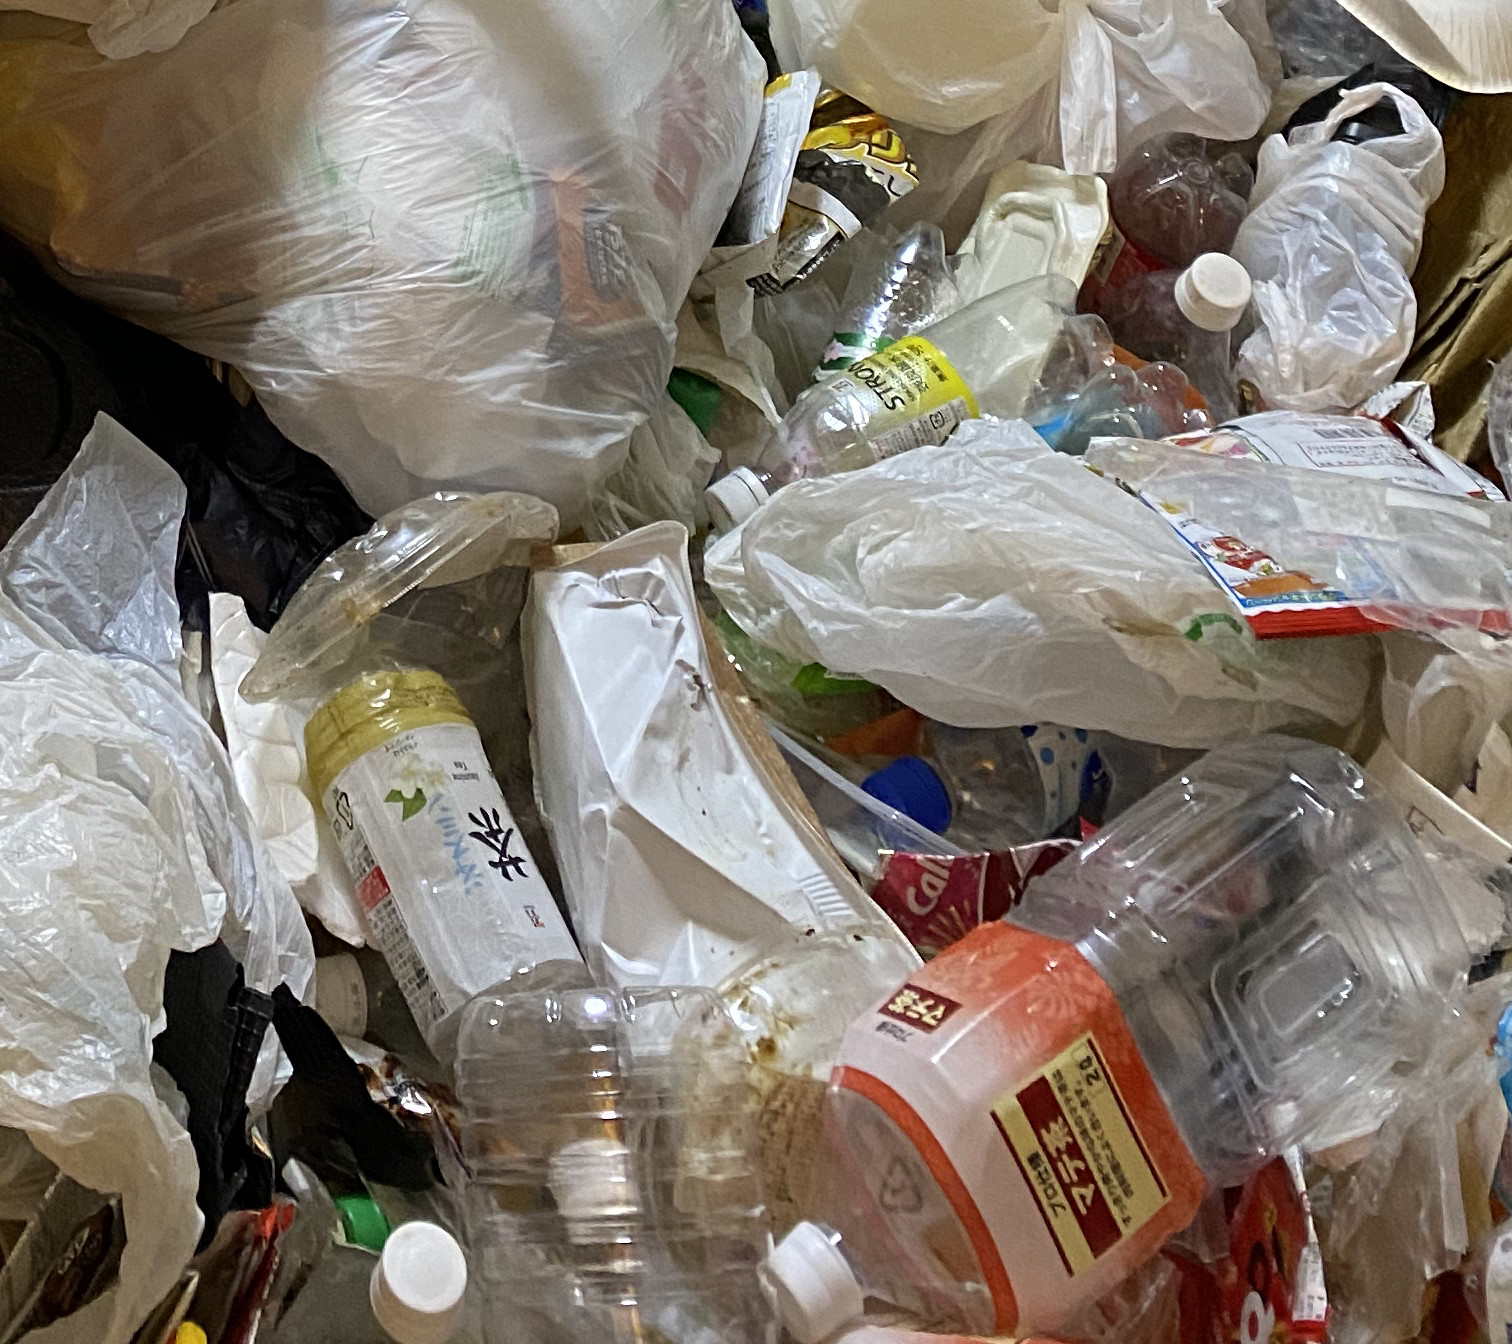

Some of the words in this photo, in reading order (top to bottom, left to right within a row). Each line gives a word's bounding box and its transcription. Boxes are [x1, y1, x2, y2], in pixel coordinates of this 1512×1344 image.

[468, 806, 529, 882] 茶
[887, 988, 946, 1027] マテ茶
[1027, 1151, 1067, 1218] プロ仕様
[1039, 1115, 1095, 1216] マテ茶
